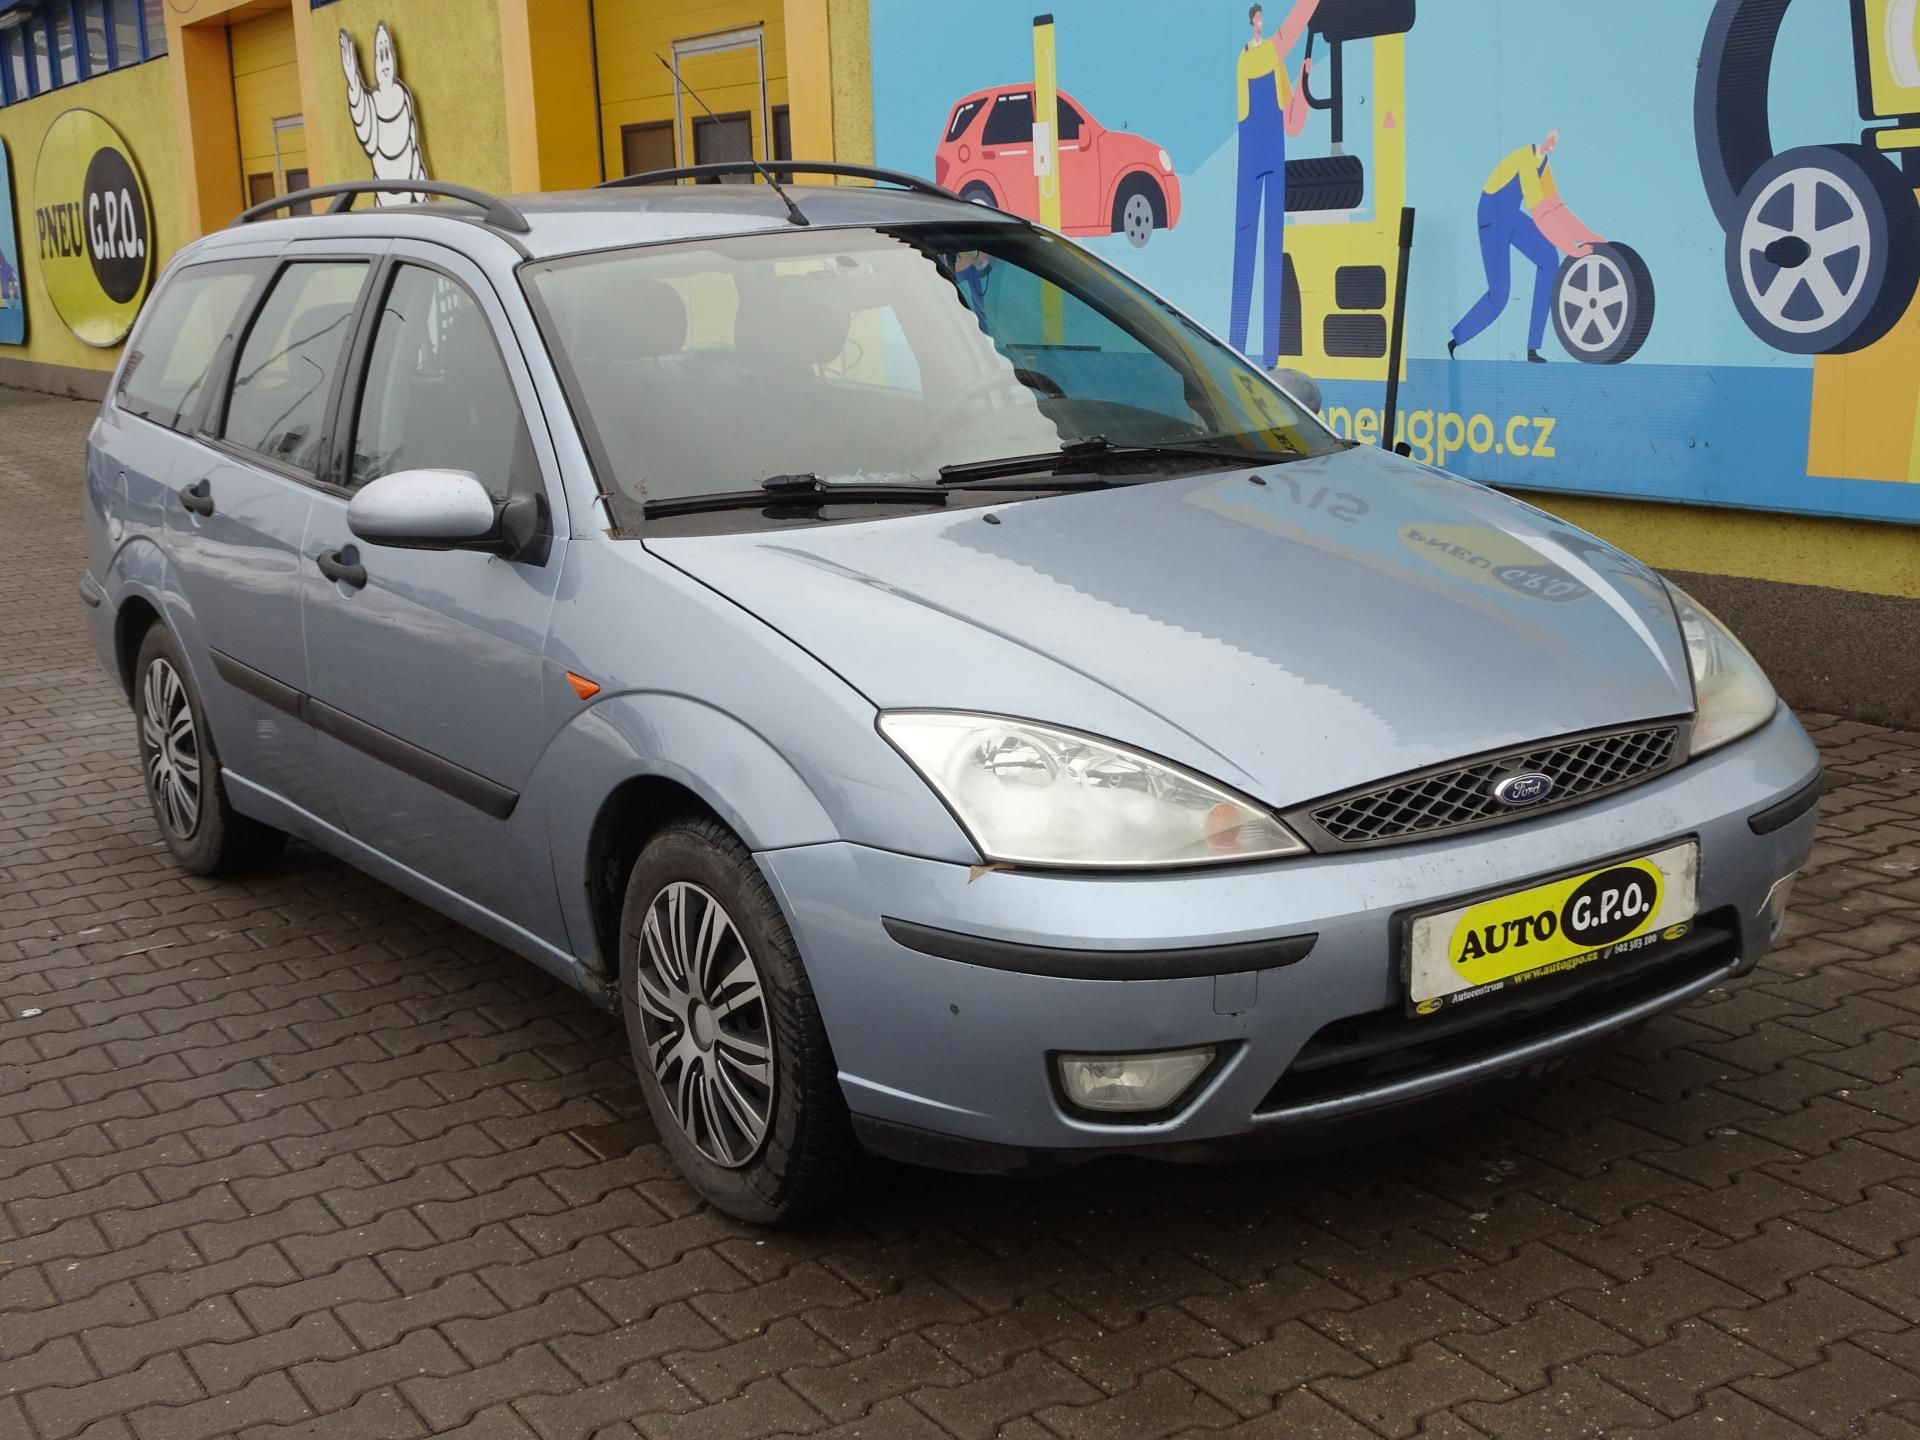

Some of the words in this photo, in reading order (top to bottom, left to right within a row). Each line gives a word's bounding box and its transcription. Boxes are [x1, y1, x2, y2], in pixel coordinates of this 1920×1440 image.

[36, 201, 82, 259] PNEU
[89, 187, 145, 259] G.P.O.
[1317, 406, 1556, 467] neugpo.cz
[1512, 779, 1541, 798] Ford
[1457, 910, 1557, 963] AUTO
[1571, 882, 1650, 931] G.P.O.
[1451, 981, 1504, 1004] Autocentrum
[1514, 951, 1599, 984] www.autogpo.cz
